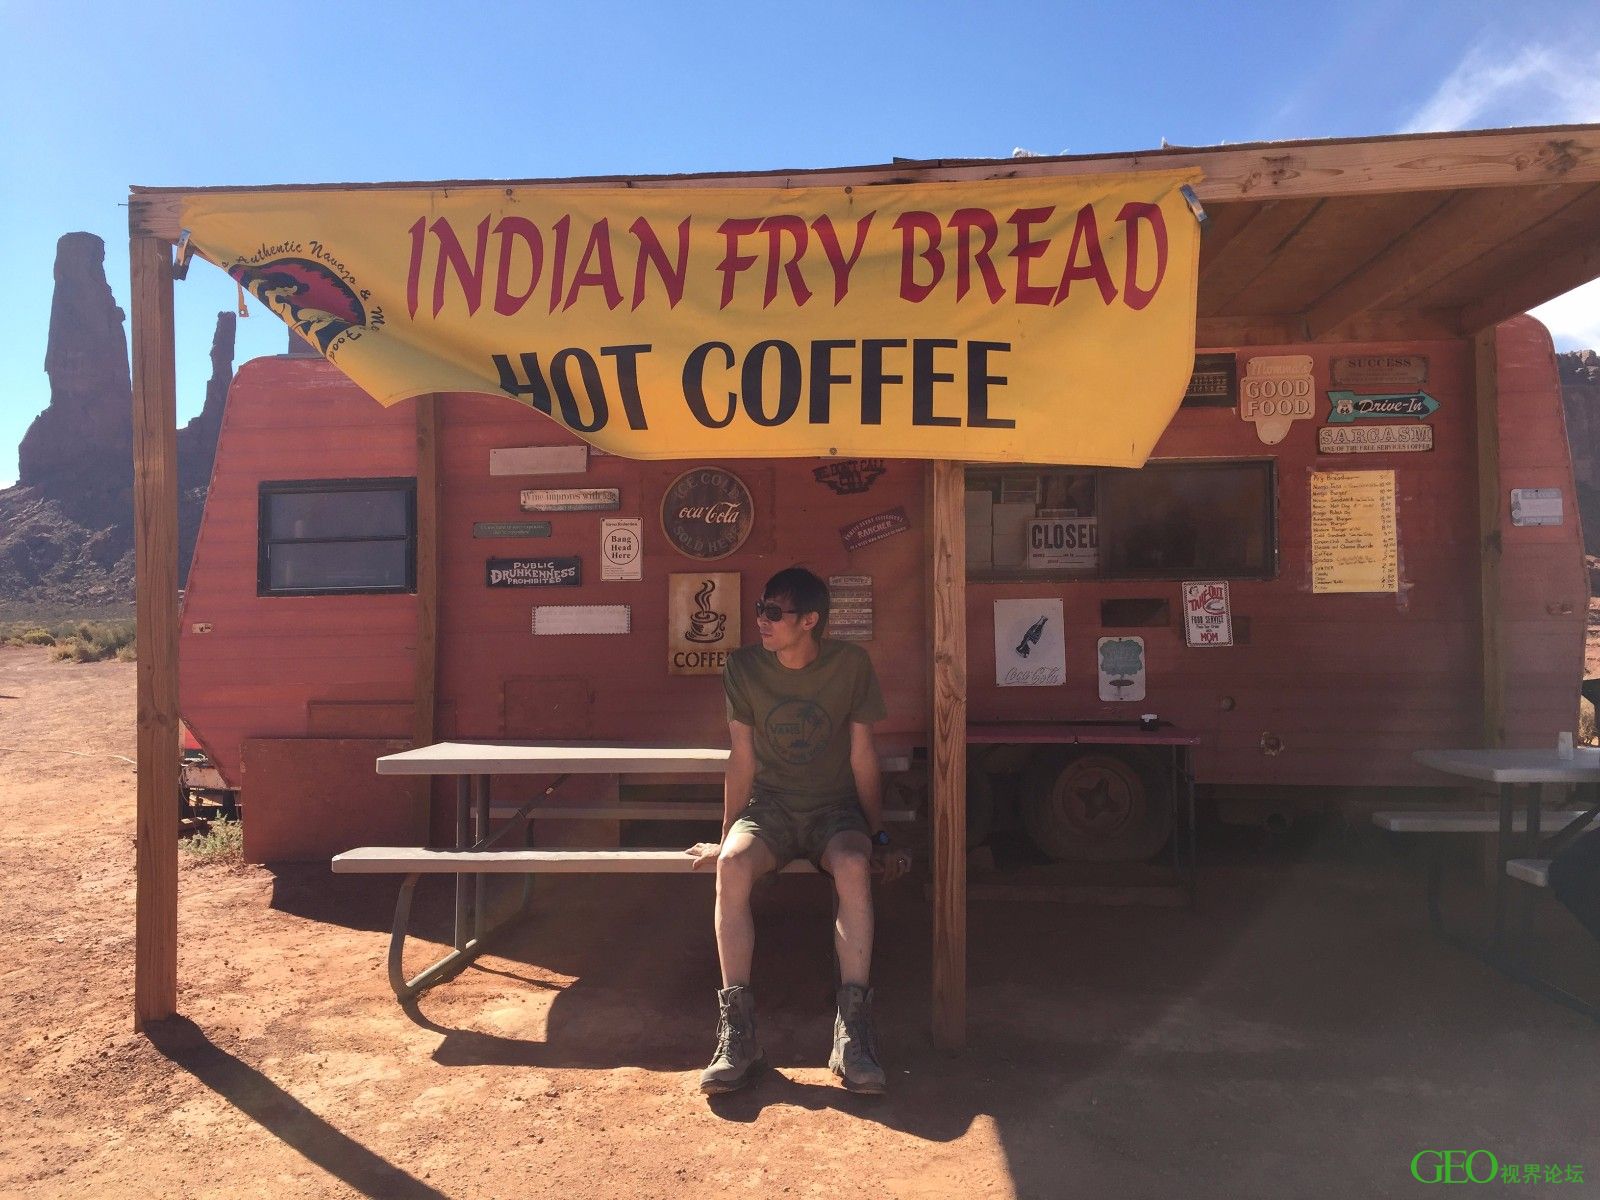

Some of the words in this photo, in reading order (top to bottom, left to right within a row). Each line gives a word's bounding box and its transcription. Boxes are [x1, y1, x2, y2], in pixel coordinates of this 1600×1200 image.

[236, 241, 303, 264] Authentic
[309, 241, 356, 285] Navajo
[407, 213, 691, 321] INDIAN
[715, 210, 876, 311] FRY
[892, 202, 1168, 310] BREAD
[1348, 358, 1412, 368] SUCCESS
[492, 344, 652, 432] HOT
[682, 339, 1016, 429] COFFEE
[1246, 379, 1310, 399] GOOD
[1247, 399, 1310, 416] FOOD
[1358, 398, 1423, 414] Drive-In
[1320, 427, 1432, 446] SARCASM
[857, 520, 892, 539] RANCHER
[1032, 524, 1099, 549] CLOSED
[490, 566, 576, 585] DRUNKENNESS
[1191, 616, 1203, 624] FOOD
[1200, 633, 1219, 642] MOM
[674, 652, 729, 667] COFFE
